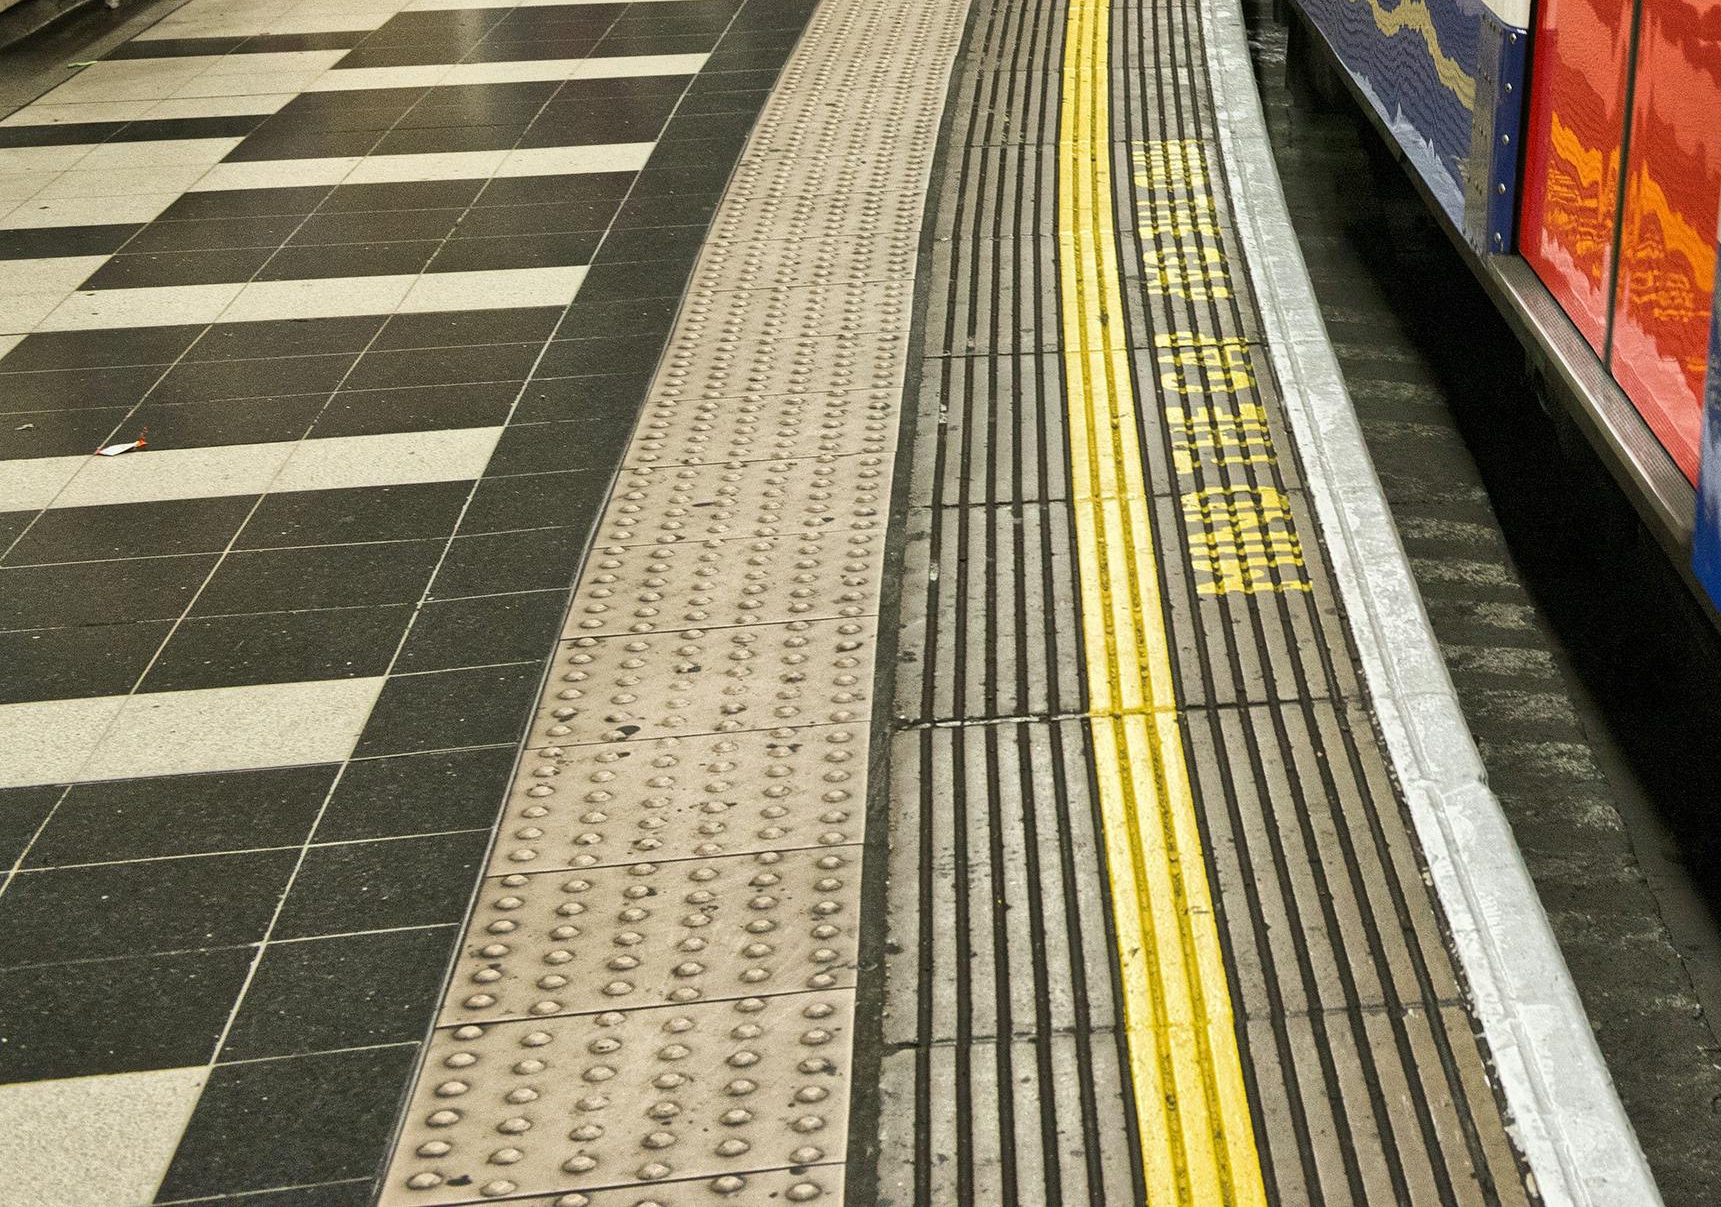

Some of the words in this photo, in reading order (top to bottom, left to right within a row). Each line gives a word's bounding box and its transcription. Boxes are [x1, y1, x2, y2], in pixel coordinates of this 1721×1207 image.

[1130, 139, 1208, 188] MIND
[1136, 194, 1221, 239] THE
[1142, 246, 1233, 299] GAP
[1153, 331, 1254, 395] GAP
[1166, 402, 1279, 475] THE
[1182, 485, 1314, 595] MIND
